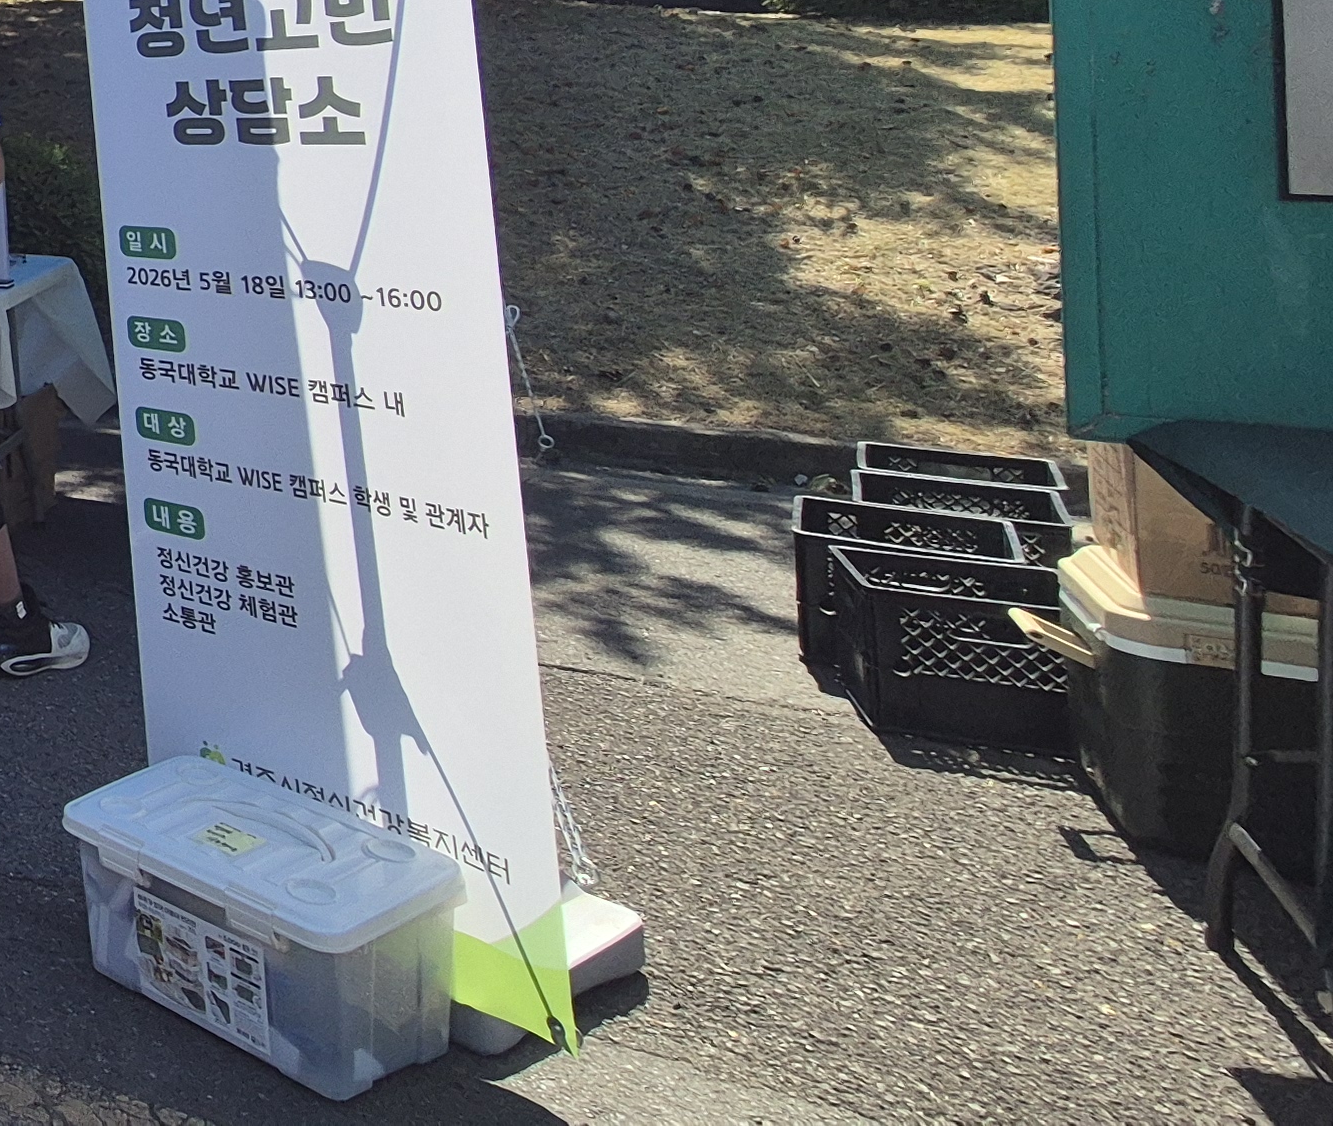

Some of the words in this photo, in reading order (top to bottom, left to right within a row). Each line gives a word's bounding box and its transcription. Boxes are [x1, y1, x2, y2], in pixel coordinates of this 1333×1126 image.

[166, 75, 366, 146] 상담소
[126, 266, 192, 292] 2026년
[199, 271, 232, 295] 5월
[241, 275, 286, 299] 18일
[294, 279, 352, 304] 13:00
[360, 286, 443, 312] ~16:00
[139, 357, 240, 390] 동국대학교
[246, 372, 301, 398] WISE
[307, 378, 376, 410] 캠퍼스
[383, 391, 405, 417] 내
[147, 448, 233, 484] 동국대학교
[237, 465, 284, 492] WISE
[289, 474, 348, 506] 캠퍼스
[353, 485, 392, 518] 학생
[399, 494, 418, 523] 및
[425, 502, 490, 540] 관계자
[157, 546, 229, 583] 정신건강
[236, 564, 295, 598] 홍보관
[159, 574, 232, 611] 정신건강
[238, 593, 298, 628] 체험관
[162, 602, 217, 635] 소통관
